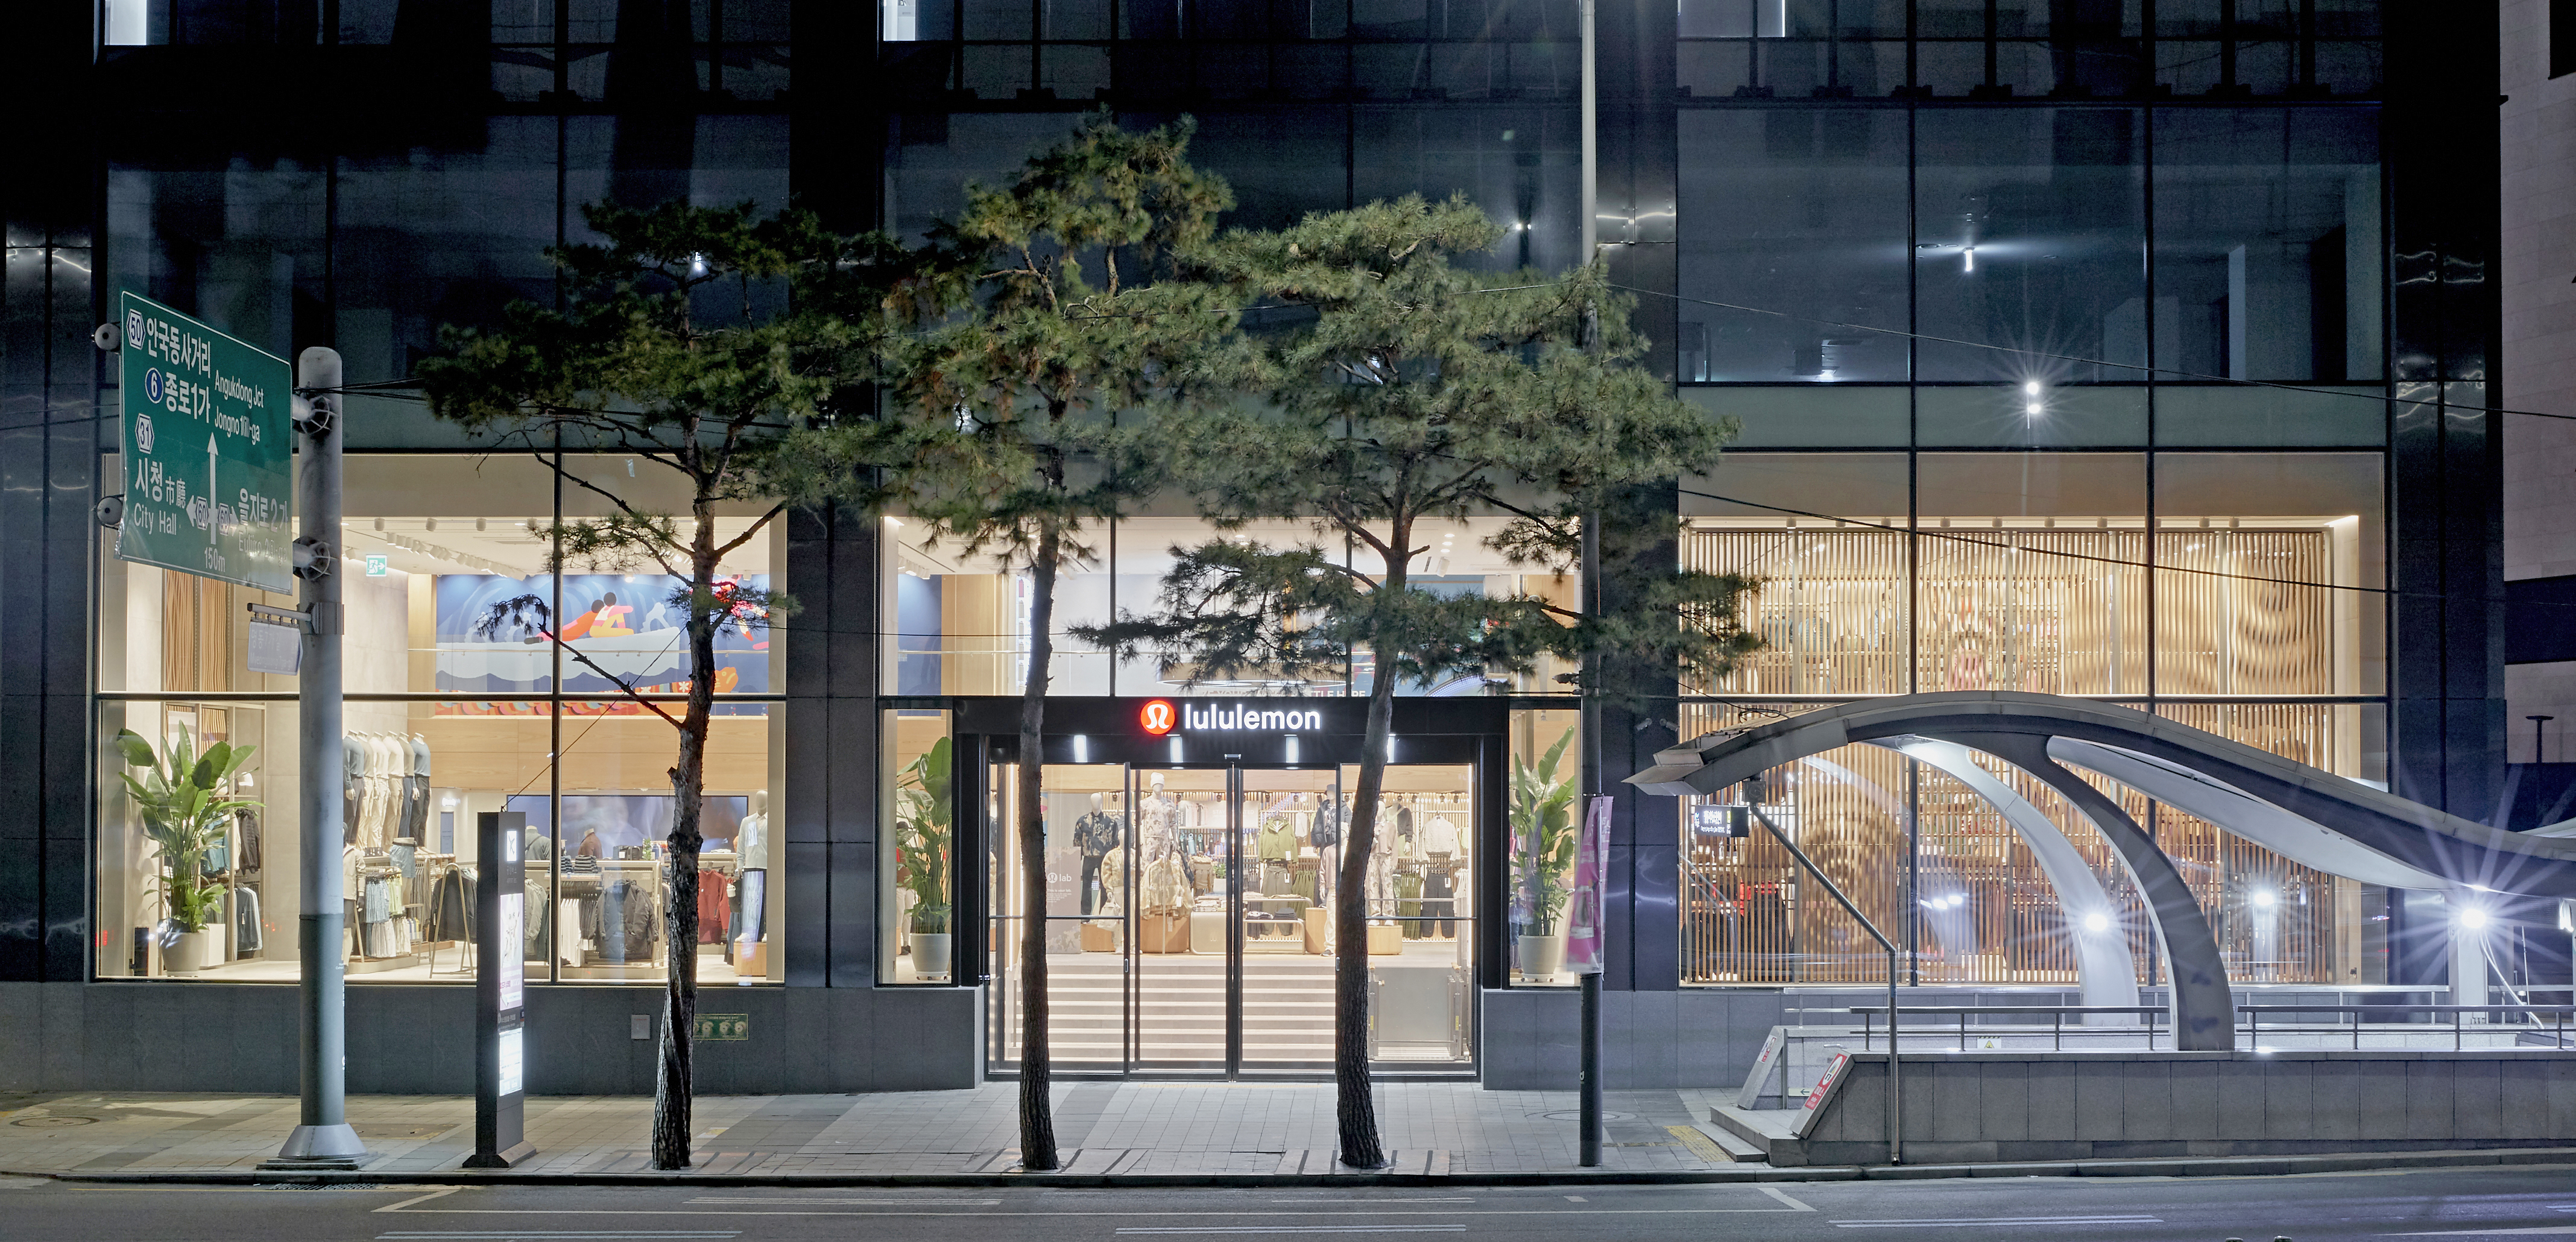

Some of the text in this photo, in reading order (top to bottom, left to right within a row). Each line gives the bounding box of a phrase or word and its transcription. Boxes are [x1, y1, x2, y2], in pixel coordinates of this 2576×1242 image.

[131, 317, 141, 342] 50
[147, 318, 210, 379] 안국동사거리
[151, 372, 157, 397] 6
[165, 371, 210, 423] 종로1가
[215, 369, 264, 409] Angukdong Jct
[140, 421, 150, 446] 31
[214, 405, 239, 438] Jongno
[134, 457, 163, 502] 시청
[134, 502, 177, 535] City Hall
[198, 503, 206, 523] 60
[220, 509, 228, 529] 60
[204, 547, 226, 573] 150m
[1185, 704, 1321, 730] lululemon
